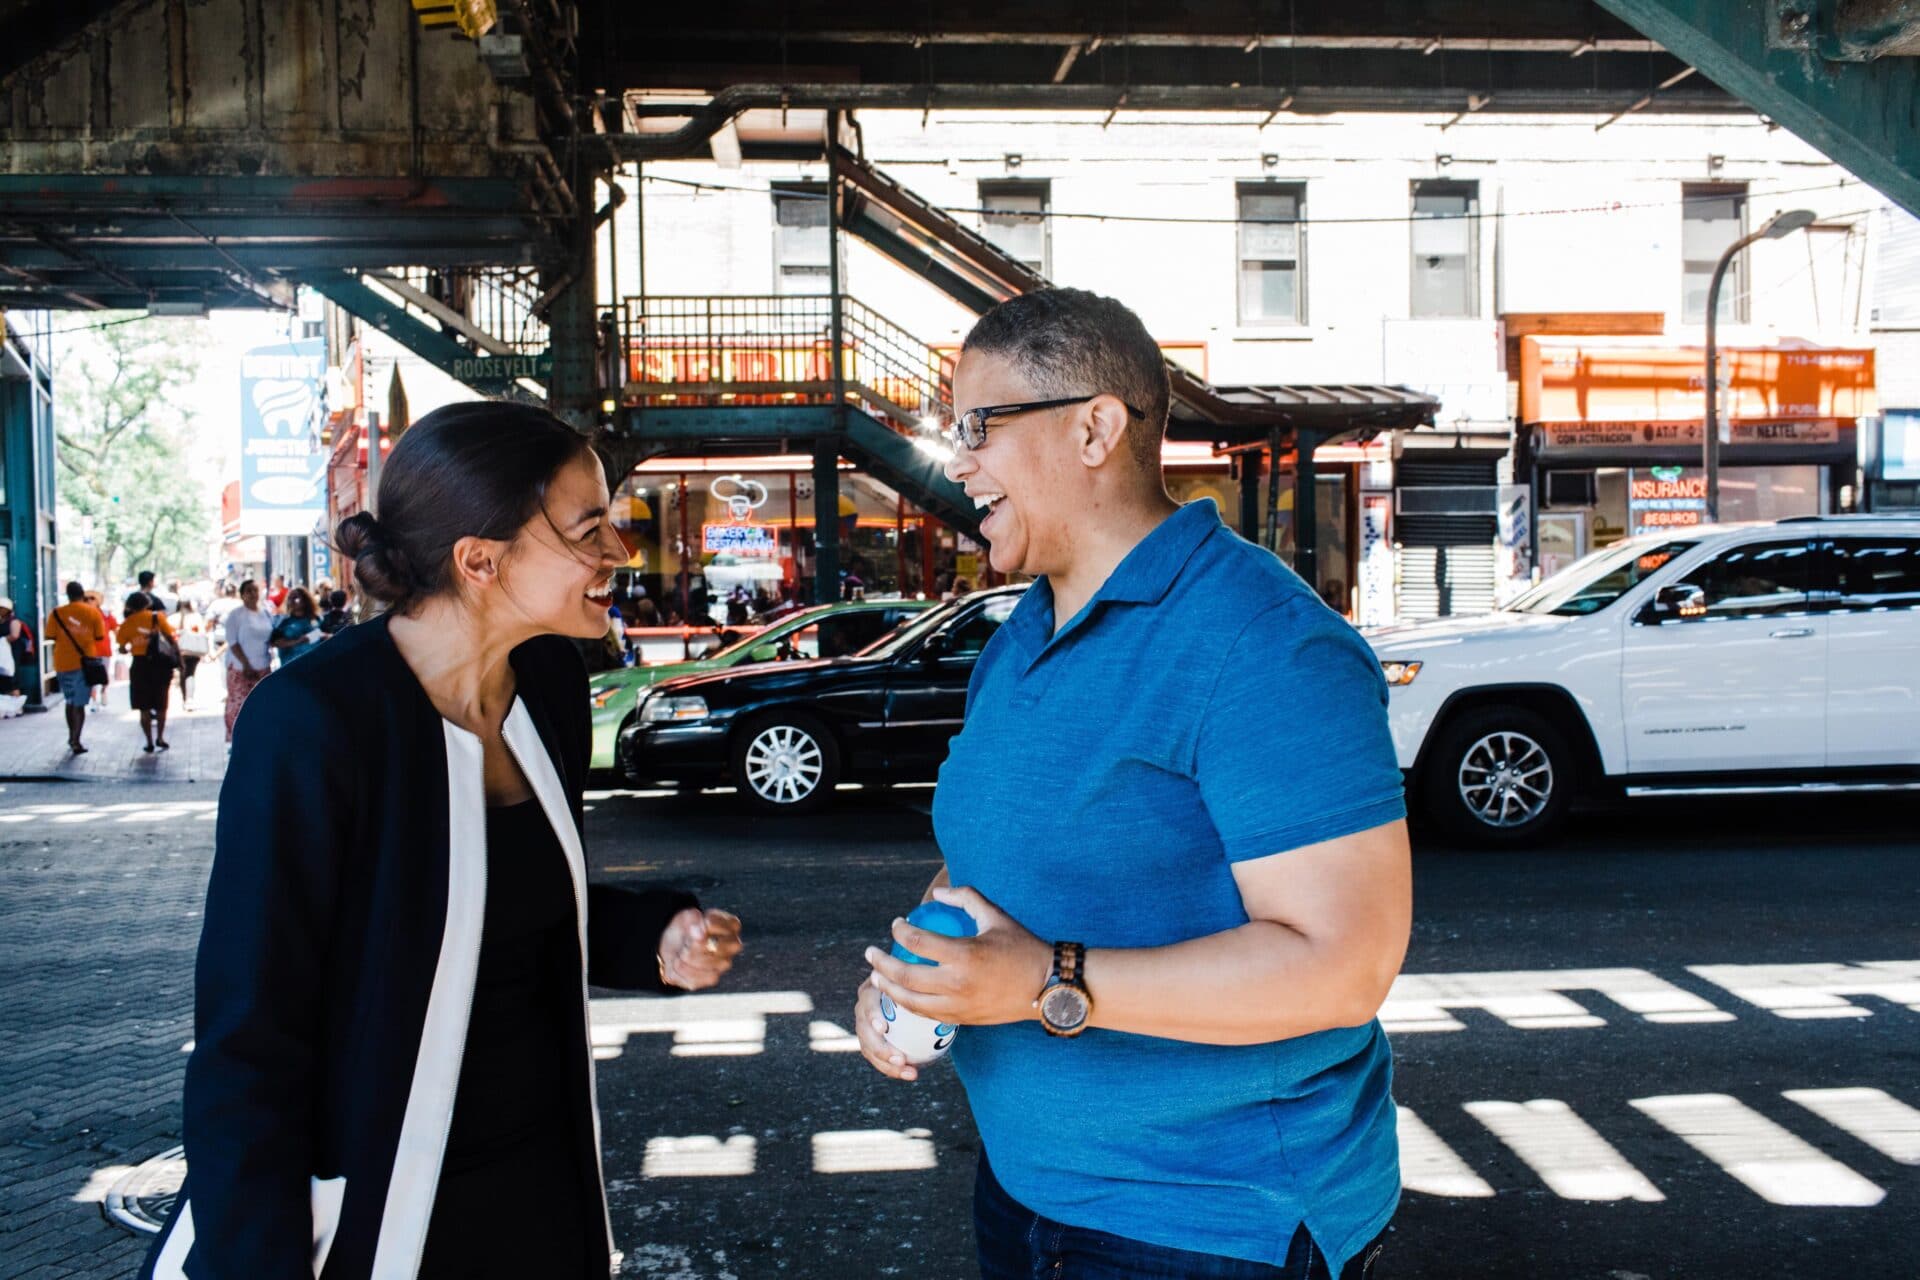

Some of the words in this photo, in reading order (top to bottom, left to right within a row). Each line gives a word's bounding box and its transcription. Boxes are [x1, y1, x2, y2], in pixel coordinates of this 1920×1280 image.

[453, 358, 537, 378] ROOSEVELT
[1557, 433, 1576, 444] CON
[1757, 424, 1797, 439] NEXTEL
[1632, 478, 1707, 498] NSURANCE
[1643, 512, 1698, 525] SEGUROS
[706, 526, 748, 538] BAKERY
